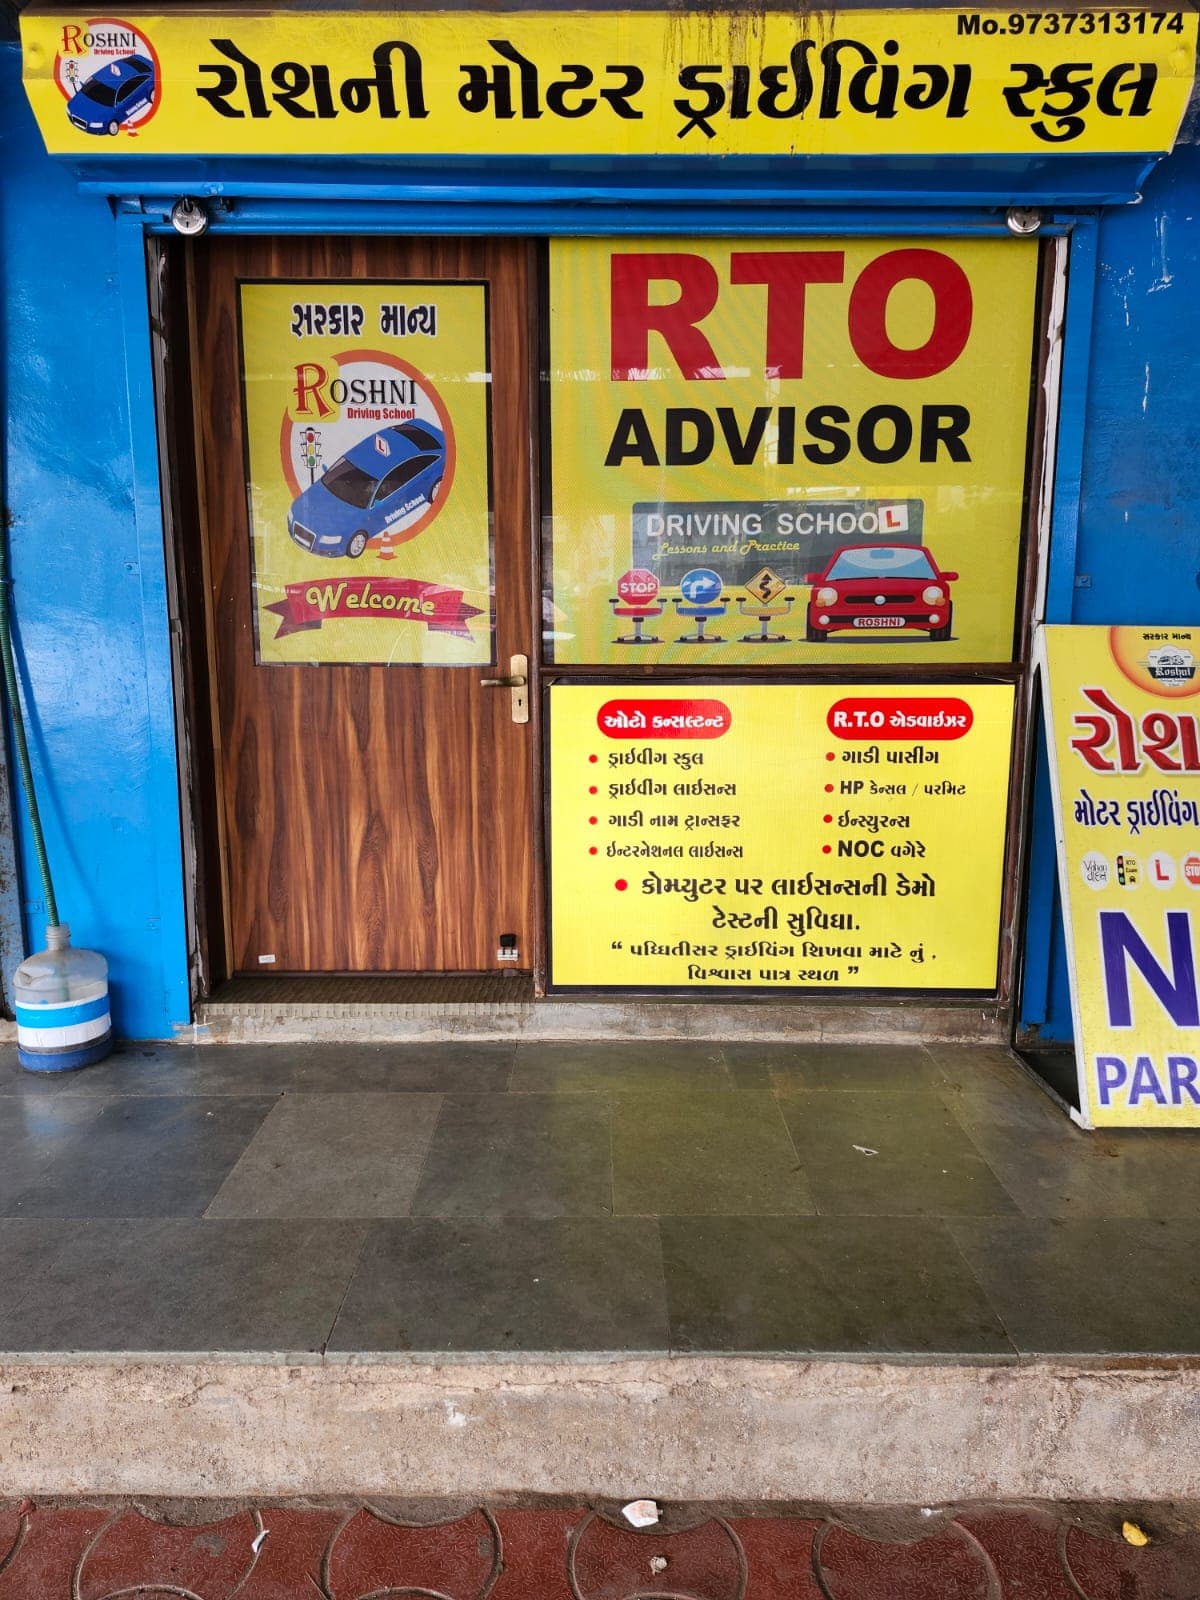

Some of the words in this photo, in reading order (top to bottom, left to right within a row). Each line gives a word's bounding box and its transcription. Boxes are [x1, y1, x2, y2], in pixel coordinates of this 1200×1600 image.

[957, 13, 1185, 36] Mo.9737313174
[61, 25, 137, 54] ROSHNI
[196, 39, 430, 118] રોશની
[459, 40, 644, 119] મોટર
[673, 39, 972, 139] ડ્રાઈવિંગ
[1002, 62, 1158, 143] સ્કુલ
[291, 304, 364, 337] સરકાર
[380, 304, 437, 337] માન્ય
[610, 248, 974, 382] RTO
[293, 362, 418, 418] ROSHNI
[347, 407, 381, 420] Driving
[382, 407, 416, 420] School
[604, 404, 972, 467] ADVISOR
[384, 506, 406, 525] Driving
[647, 513, 762, 537] DRIVING
[777, 504, 909, 535] SCHOOL
[652, 542, 708, 560] Lessons
[711, 540, 738, 554] and
[739, 540, 800, 555] Practice
[620, 582, 657, 593] STOP
[305, 582, 436, 617] Welcome
[858, 617, 901, 628] ROSHNI
[604, 710, 646, 728] ઓટો
[652, 715, 724, 728] કન્સલ્ટન્ટ
[834, 711, 885, 728] R.T.O
[889, 710, 967, 728] એડવાઈઝર
[673, 752, 704, 770] સ્કુલ
[842, 745, 879, 764] ગાડી
[673, 778, 737, 796] લાઈસન્સ
[840, 780, 864, 795] HP
[869, 779, 906, 795] કેન્સલ
[924, 780, 966, 795] પરમિટ
[608, 810, 643, 828] ગાડી
[650, 815, 678, 828] નામ
[684, 814, 740, 831] ટ્રાન્સફર
[838, 809, 910, 833] ઈન્સ્યુરન્સ
[1074, 789, 1121, 826] મોટર
[1127, 789, 1199, 835] ડ્રાઈવિંગ
[606, 840, 683, 858] ઈન્ટરનેશનલ
[688, 840, 744, 858] લાઈસન્સ
[838, 840, 885, 857] NOC
[890, 841, 926, 858] વગેરે
[1155, 859, 1169, 881] L
[641, 871, 727, 902] કોમ્પ્યુટર
[735, 878, 763, 895] પર
[771, 872, 887, 896] લાઈસન્સની
[896, 873, 936, 896] ડેમો
[712, 905, 778, 929] ટેસ્ટની
[725, 941, 794, 960] ડ્રાઈવિંગ
[802, 941, 862, 957] શિખવા
[869, 943, 902, 958] માટે
[909, 943, 925, 963] નું
[688, 964, 751, 979] વિશ્વાસ
[759, 968, 791, 980] પાત્ર
[798, 969, 839, 981] સ્થળ
[1096, 1056, 1200, 1105] PAR
